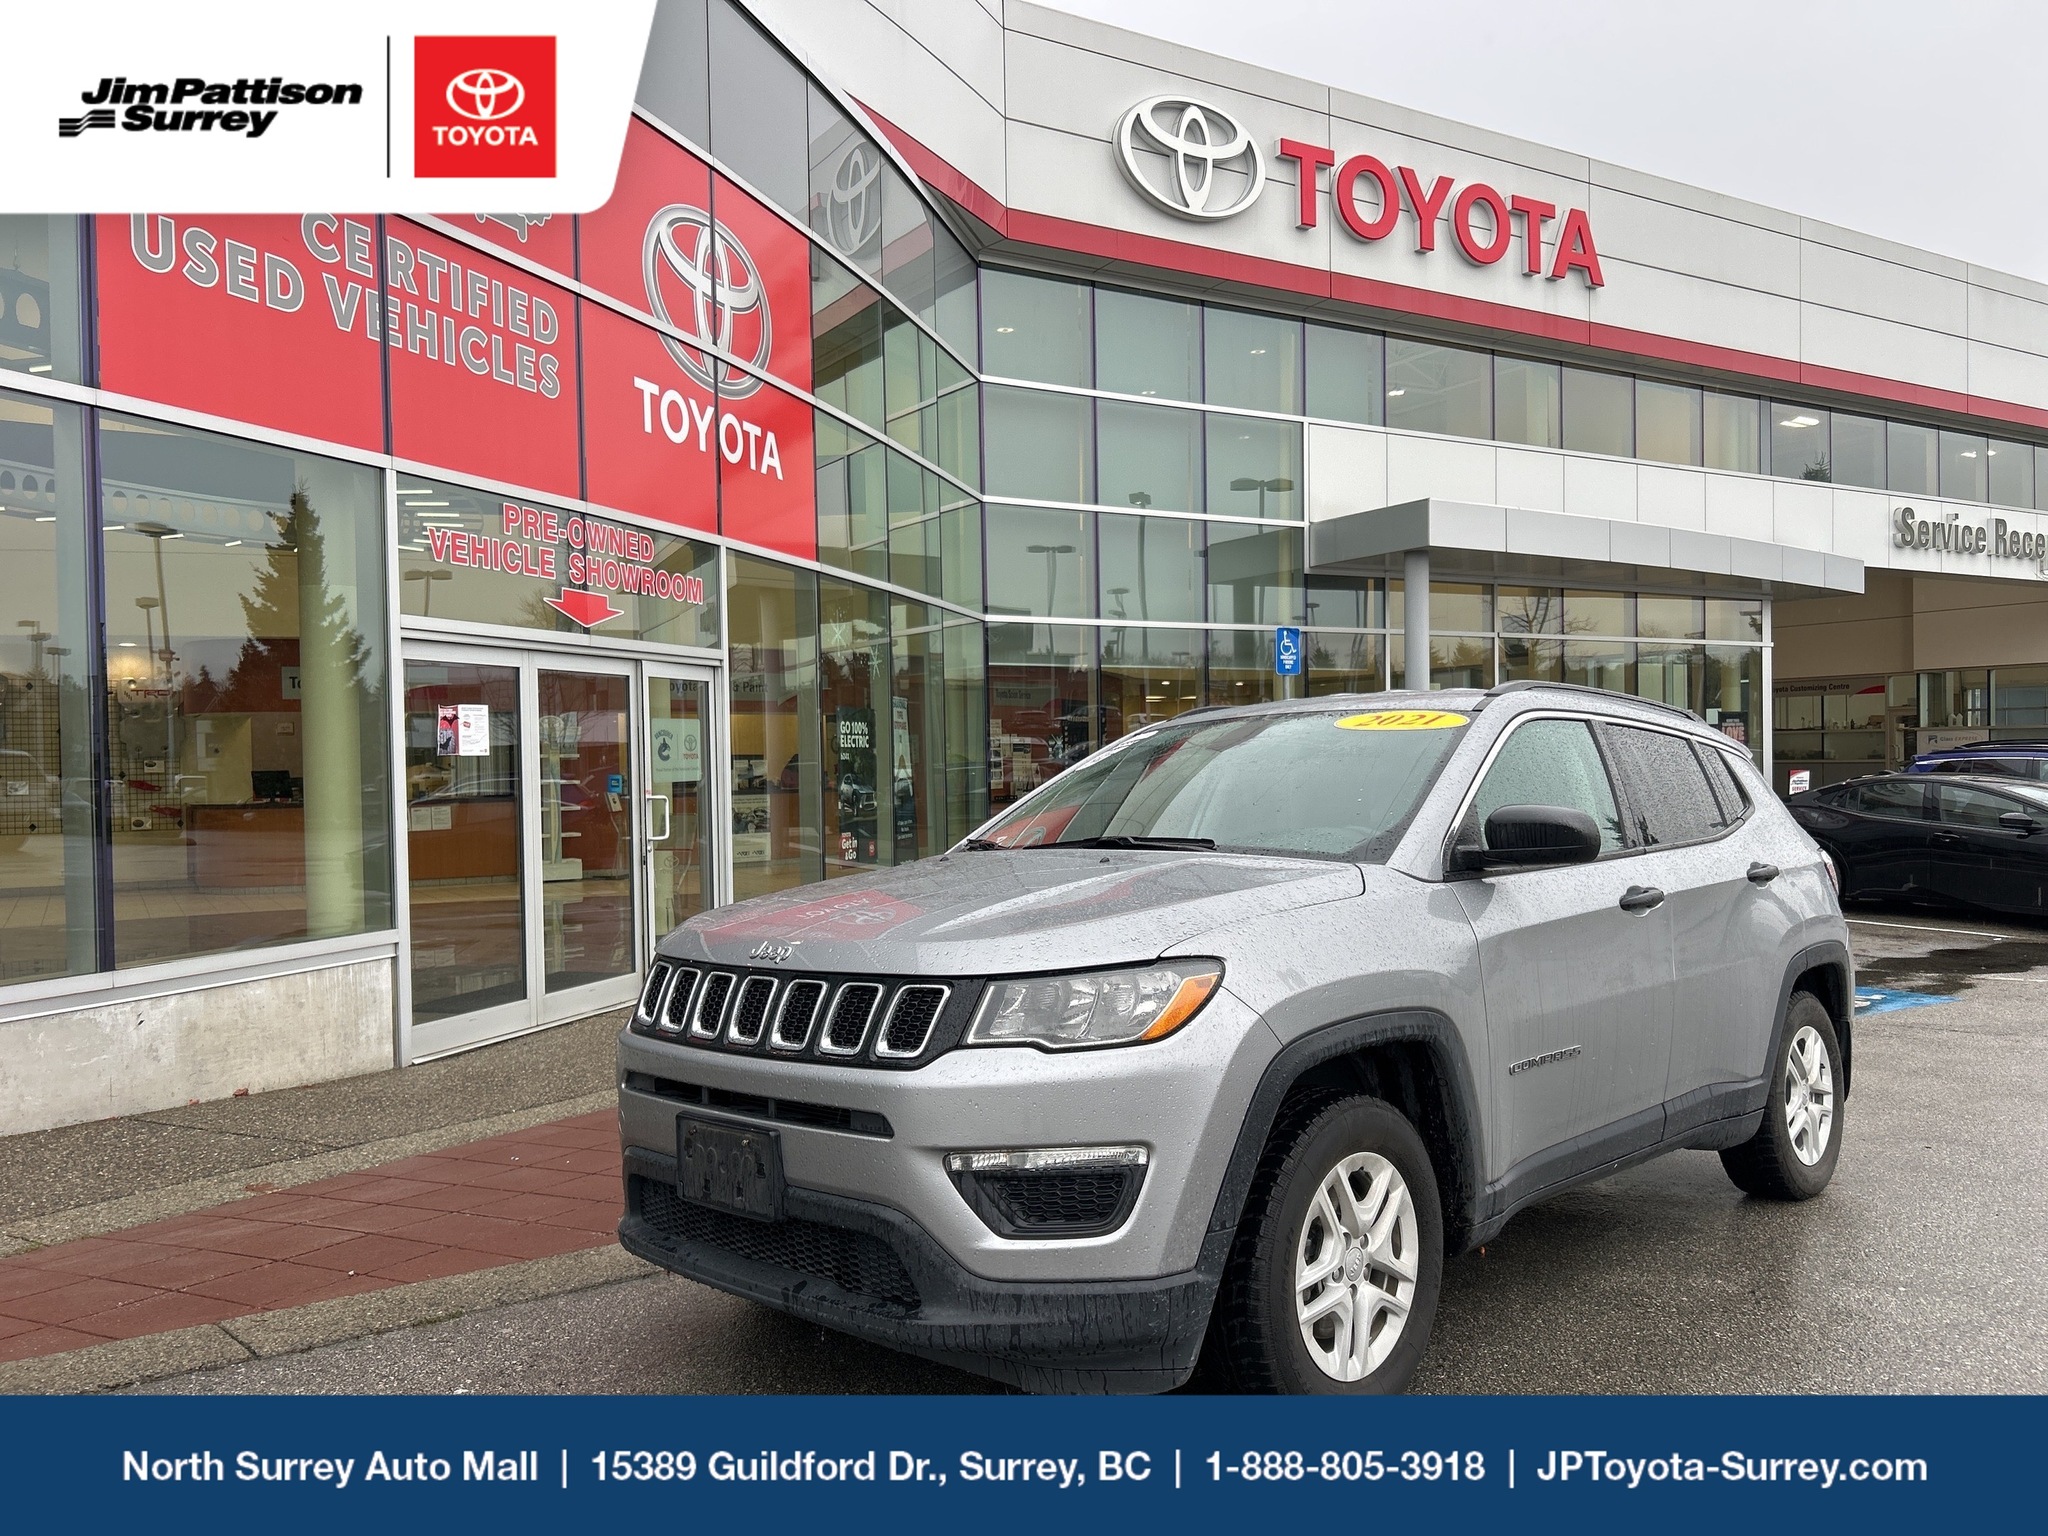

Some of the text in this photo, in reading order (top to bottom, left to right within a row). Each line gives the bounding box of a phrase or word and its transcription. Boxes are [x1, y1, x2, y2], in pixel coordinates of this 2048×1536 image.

[1275, 137, 1605, 289] TOYOTA
[302, 213, 558, 344] CERTIFIED
[130, 213, 561, 399] USED VEHICLES
[633, 376, 784, 481] TOYOTA
[503, 502, 655, 563] PRE-OWNED
[1893, 506, 1987, 554] Service
[427, 526, 704, 605] VEHICLE SHOWROOM
[131, 689, 172, 698] TRD
[669, 682, 698, 694] oyota
[743, 681, 769, 693] Paint
[1789, 684, 1827, 693] Customizing
[1828, 683, 1850, 691] Centre
[840, 720, 869, 735] GO 100%
[1355, 714, 1447, 727] 2021
[840, 735, 870, 749] ELECTRIC
[841, 838, 852, 850] Get
[750, 940, 794, 965] Jeep
[1508, 1044, 1582, 1076] COMPASS
